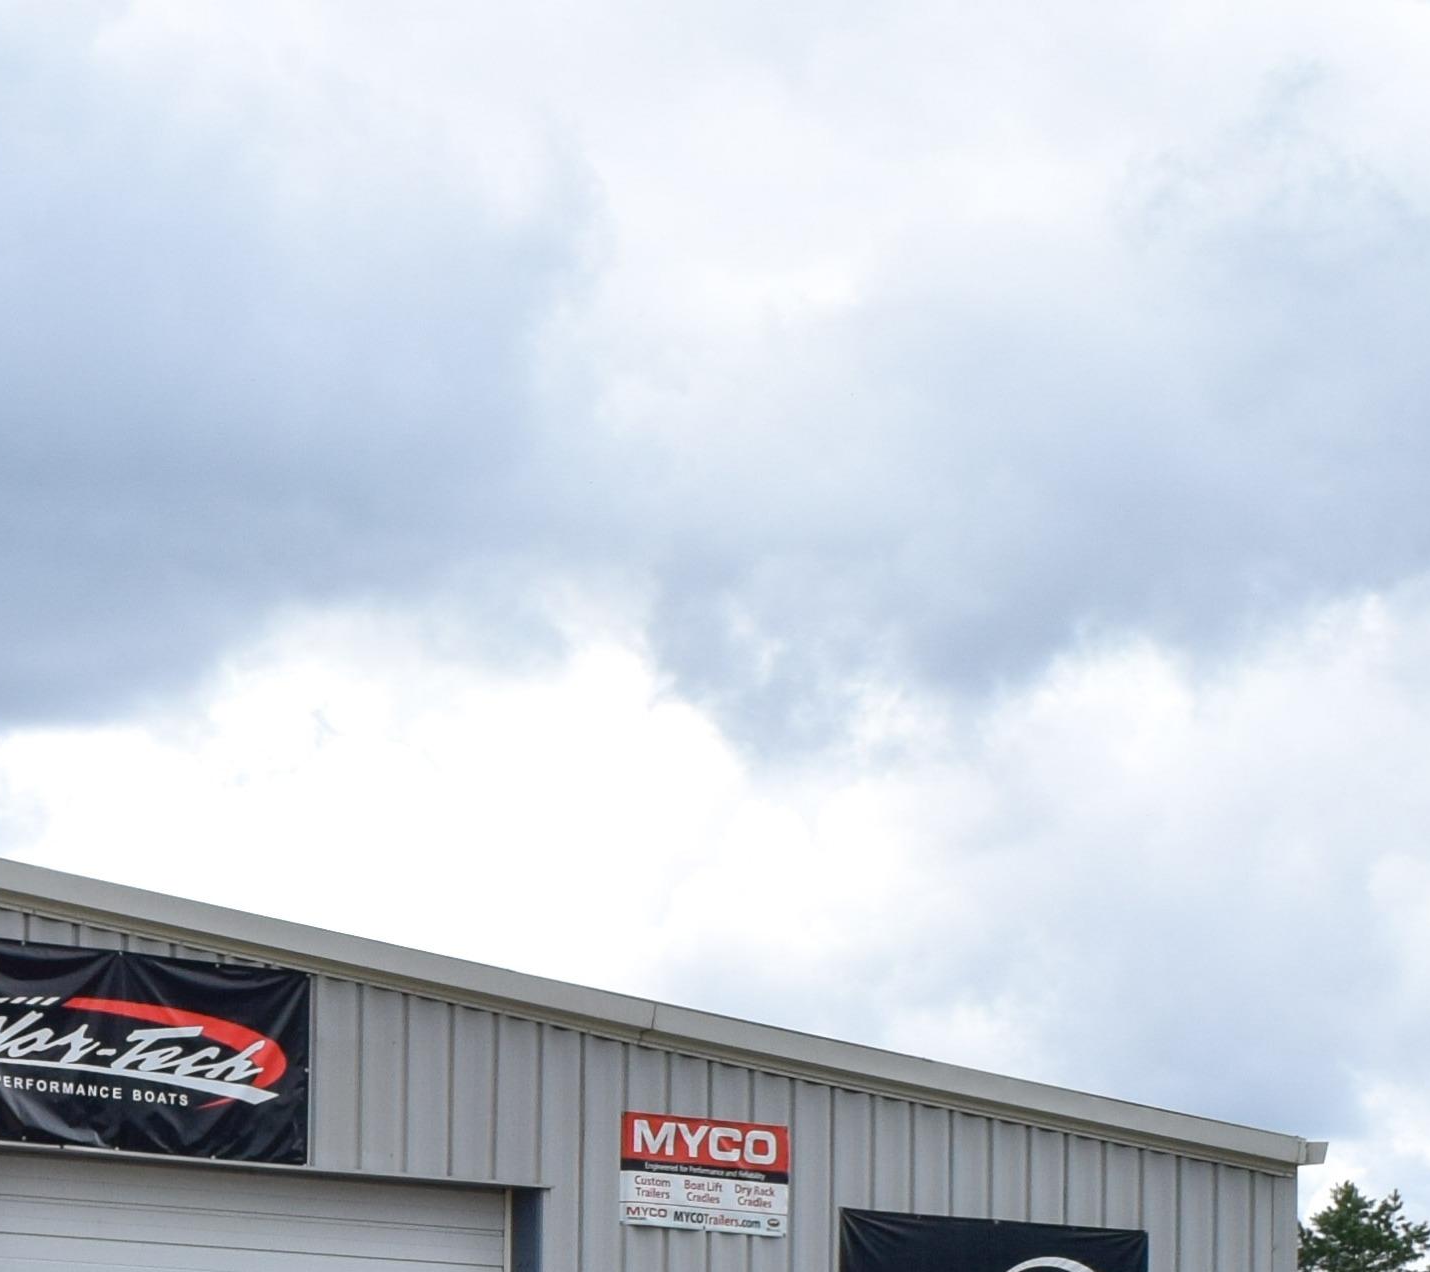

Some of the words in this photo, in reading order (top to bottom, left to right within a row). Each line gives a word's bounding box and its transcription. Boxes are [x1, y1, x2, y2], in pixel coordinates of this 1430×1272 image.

[132, 1088, 190, 1107] BOATS
[633, 1119, 778, 1166] MYCO
[634, 1175, 672, 1188] Custom
[684, 1179, 706, 1192] Boat
[707, 1181, 723, 1193] Lift
[635, 1187, 670, 1200] Trailers
[686, 1191, 721, 1204] Cradles
[734, 1184, 753, 1198] Dry
[754, 1186, 775, 1198] Rack
[737, 1196, 772, 1209] Cradles
[626, 1206, 668, 1218] MYCO
[673, 1210, 762, 1229] MYCOTrailers.com
